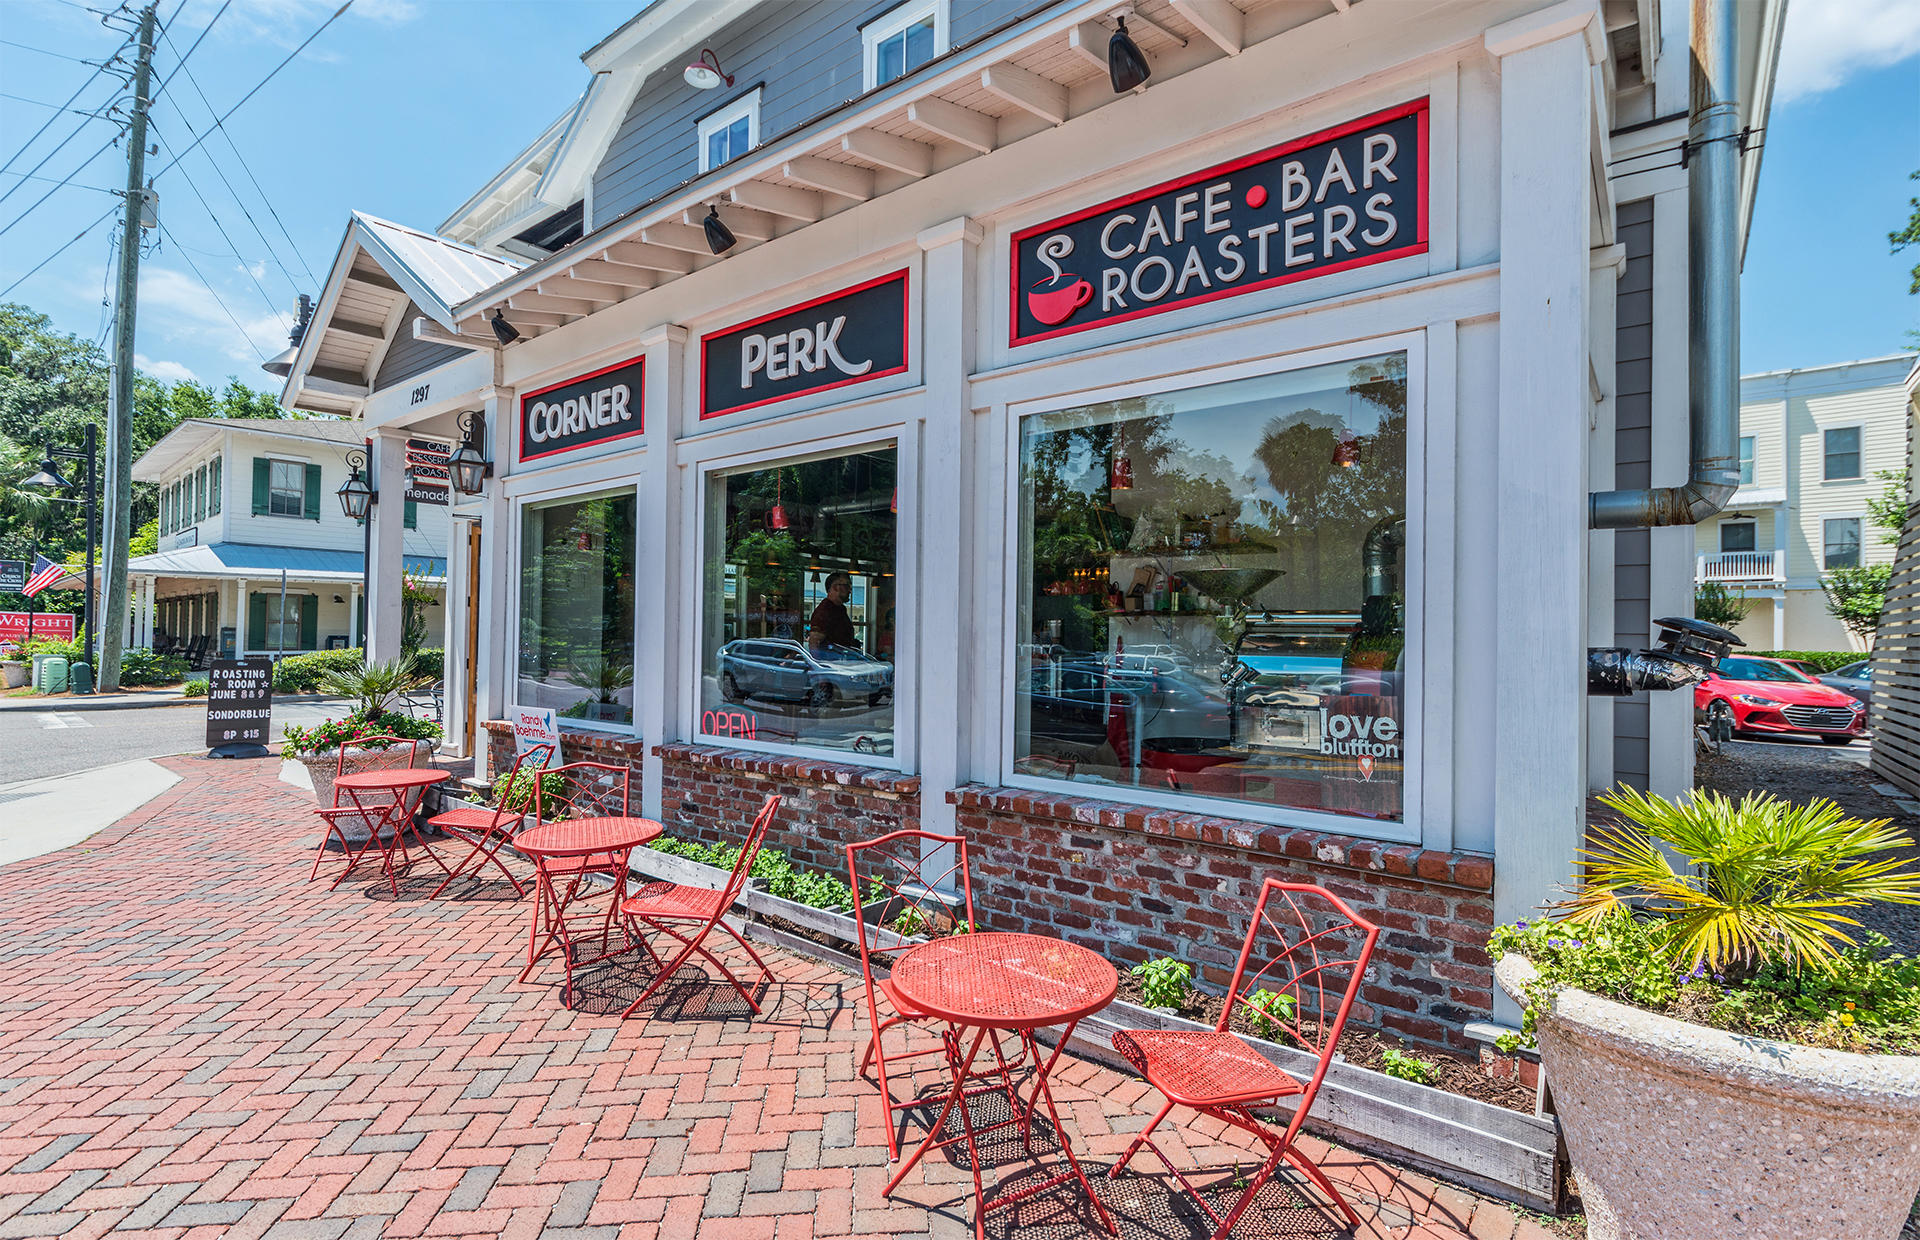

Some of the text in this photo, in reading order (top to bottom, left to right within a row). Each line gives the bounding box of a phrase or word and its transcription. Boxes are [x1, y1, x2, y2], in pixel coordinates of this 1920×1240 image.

[1100, 132, 1398, 260] CAFE BAR
[1102, 192, 1398, 312] ROASTERS
[741, 315, 873, 389] PERK
[411, 383, 430, 406] 1297
[528, 383, 632, 444] CORNER
[210, 690, 237, 699] JUNE
[258, 689, 265, 698] 9
[227, 679, 256, 689] ROOM
[208, 709, 271, 720] SONDORBLUE
[520, 713, 543, 728] Randy
[702, 710, 756, 741] OPEN
[1319, 707, 1399, 741] love
[223, 729, 260, 740] 8P $15
[1320, 736, 1399, 759] bluffton
